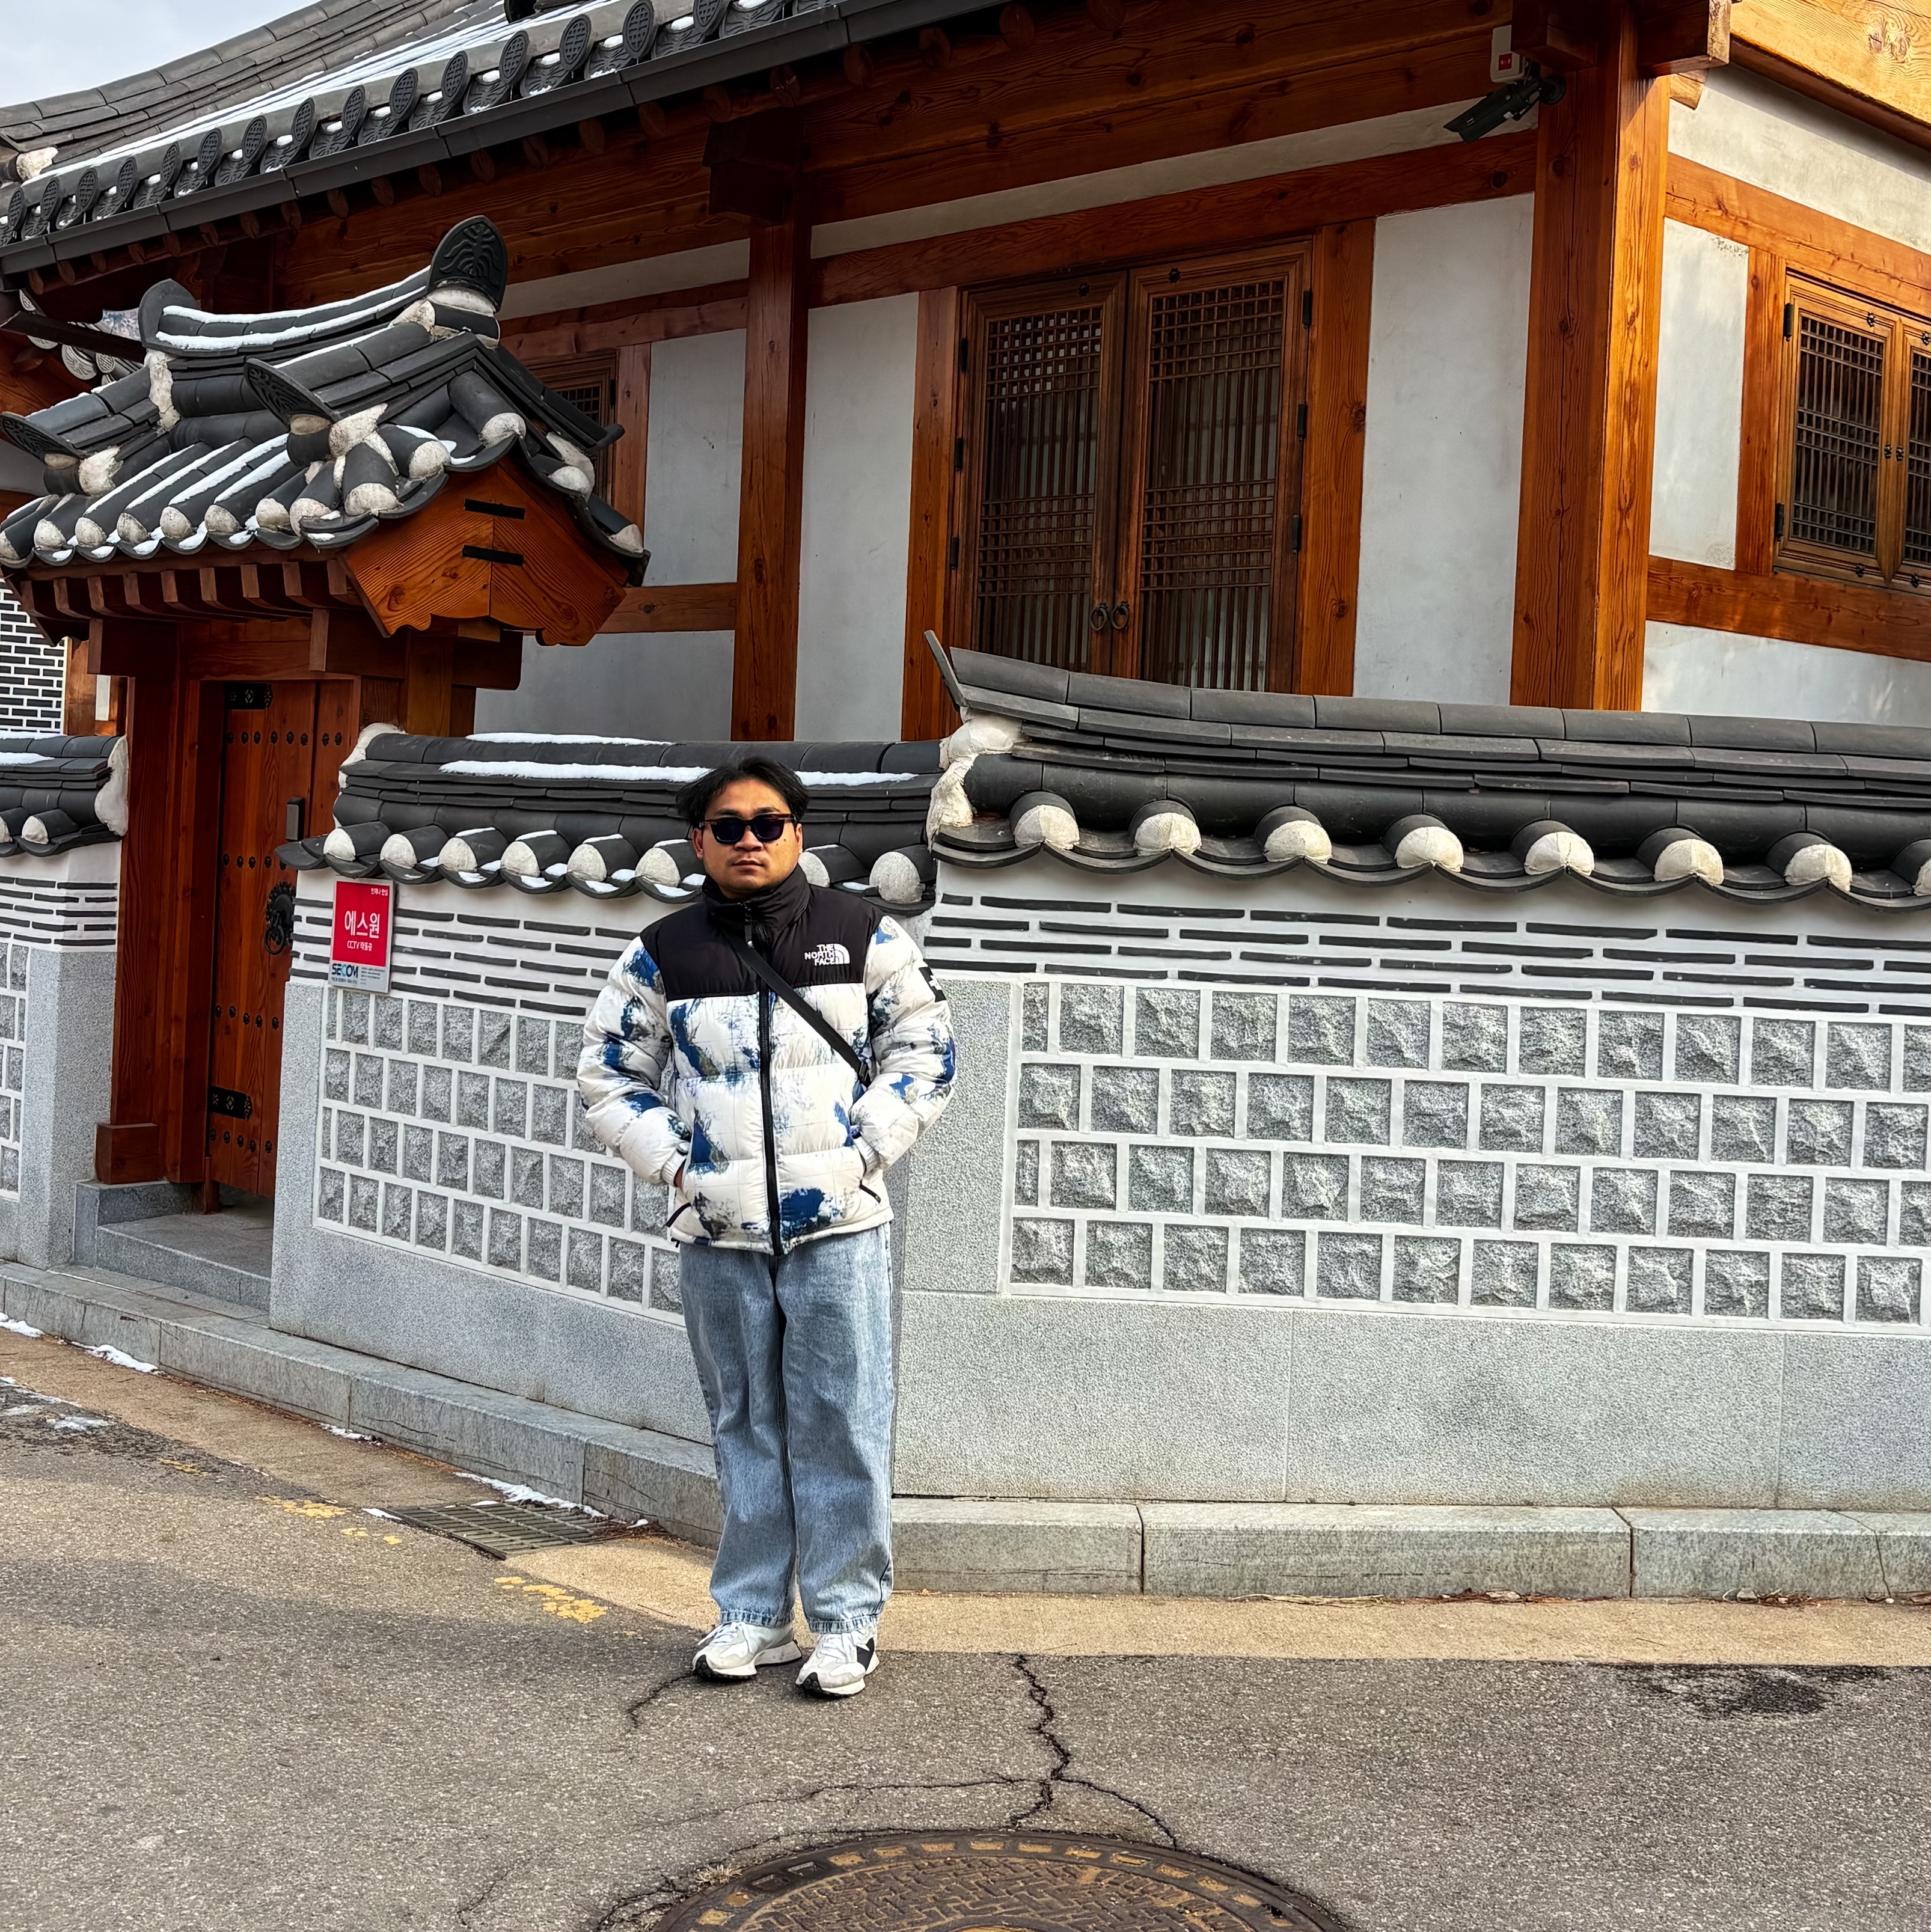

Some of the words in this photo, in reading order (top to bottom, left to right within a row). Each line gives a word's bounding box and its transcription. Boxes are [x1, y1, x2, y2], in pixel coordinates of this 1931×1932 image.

[344, 910, 381, 939] 에스원
[816, 943, 834, 952] THE
[804, 949, 834, 960] NORTH
[814, 957, 835, 967] FACE
[331, 963, 359, 979] SECOM
